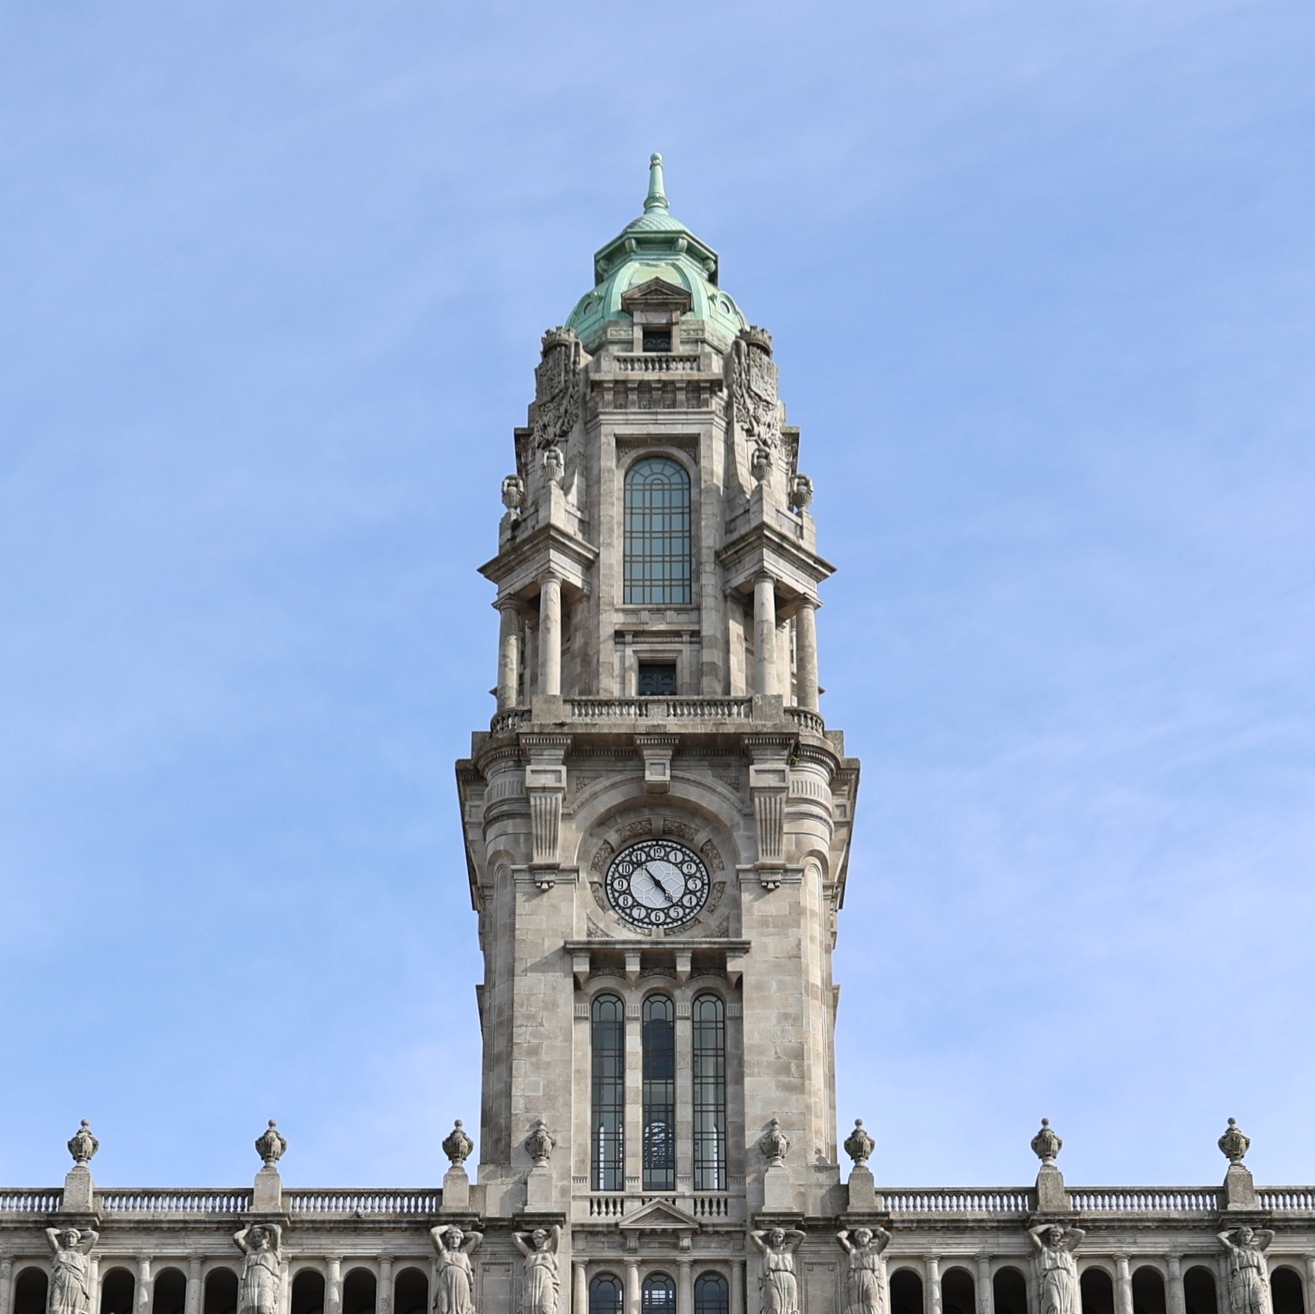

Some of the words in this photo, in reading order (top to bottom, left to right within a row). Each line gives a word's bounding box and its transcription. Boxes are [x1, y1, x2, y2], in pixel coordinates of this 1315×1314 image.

[652, 847, 662, 858] 12
[621, 863, 631, 874] 10
[686, 862, 693, 874] 2
[617, 880, 624, 890] 9
[691, 880, 698, 890] 3
[622, 896, 629, 906] 8
[687, 895, 693, 906] 4
[636, 907, 643, 918] 7
[654, 911, 661, 922] 6
[673, 907, 680, 918] 5
